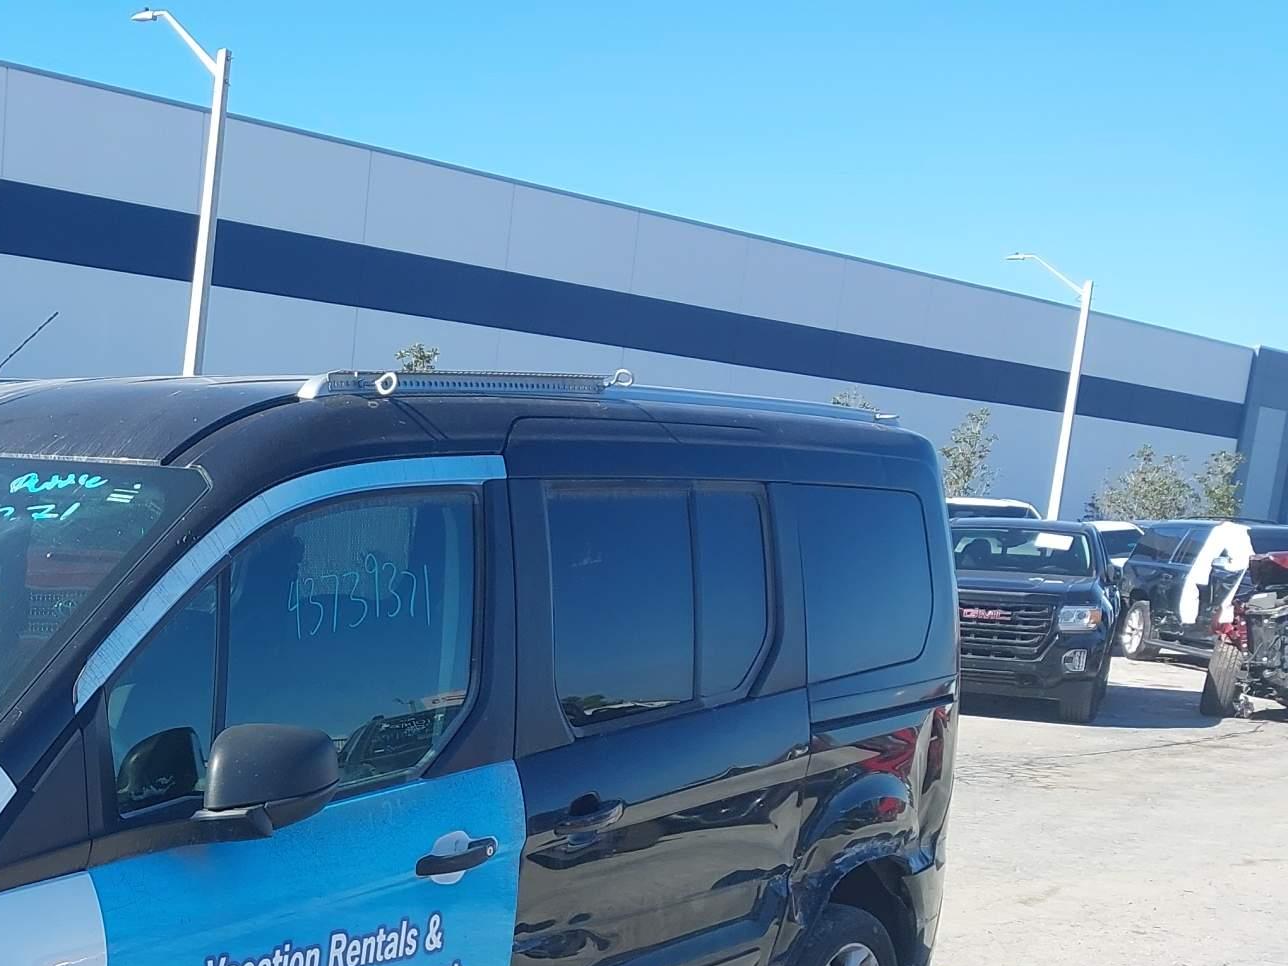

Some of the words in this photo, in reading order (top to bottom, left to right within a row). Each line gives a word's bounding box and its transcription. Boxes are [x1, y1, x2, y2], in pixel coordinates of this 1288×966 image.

[288, 553, 430, 640] 43739371
[960, 607, 1012, 621] GMC
[425, 913, 443, 952] &
